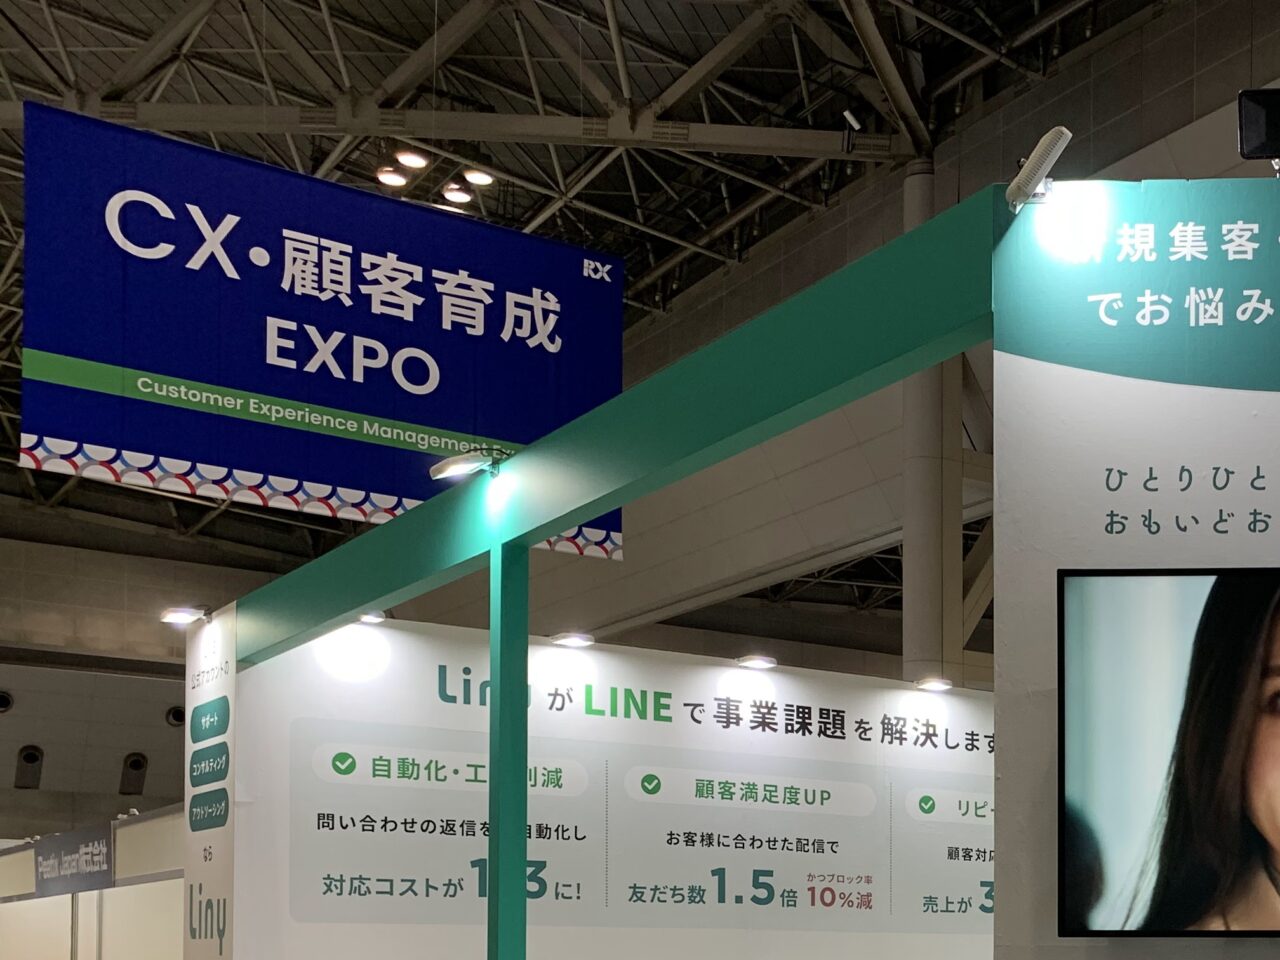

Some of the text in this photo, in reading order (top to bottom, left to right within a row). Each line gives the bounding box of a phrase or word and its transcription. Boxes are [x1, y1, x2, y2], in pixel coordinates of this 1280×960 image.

[583, 258, 612, 282] RX
[265, 316, 440, 395] EXPO
[137, 377, 244, 411] Customer
[249, 398, 358, 432] Experience
[585, 684, 673, 722] LINE
[694, 778, 831, 806] 顧客満足度UP
[958, 799, 994, 818] リピ
[666, 831, 839, 854] お客様に合わせた配信で
[806, 872, 873, 885] かつブロック率
[807, 886, 873, 910] 10%減
[189, 883, 227, 956] Liny
